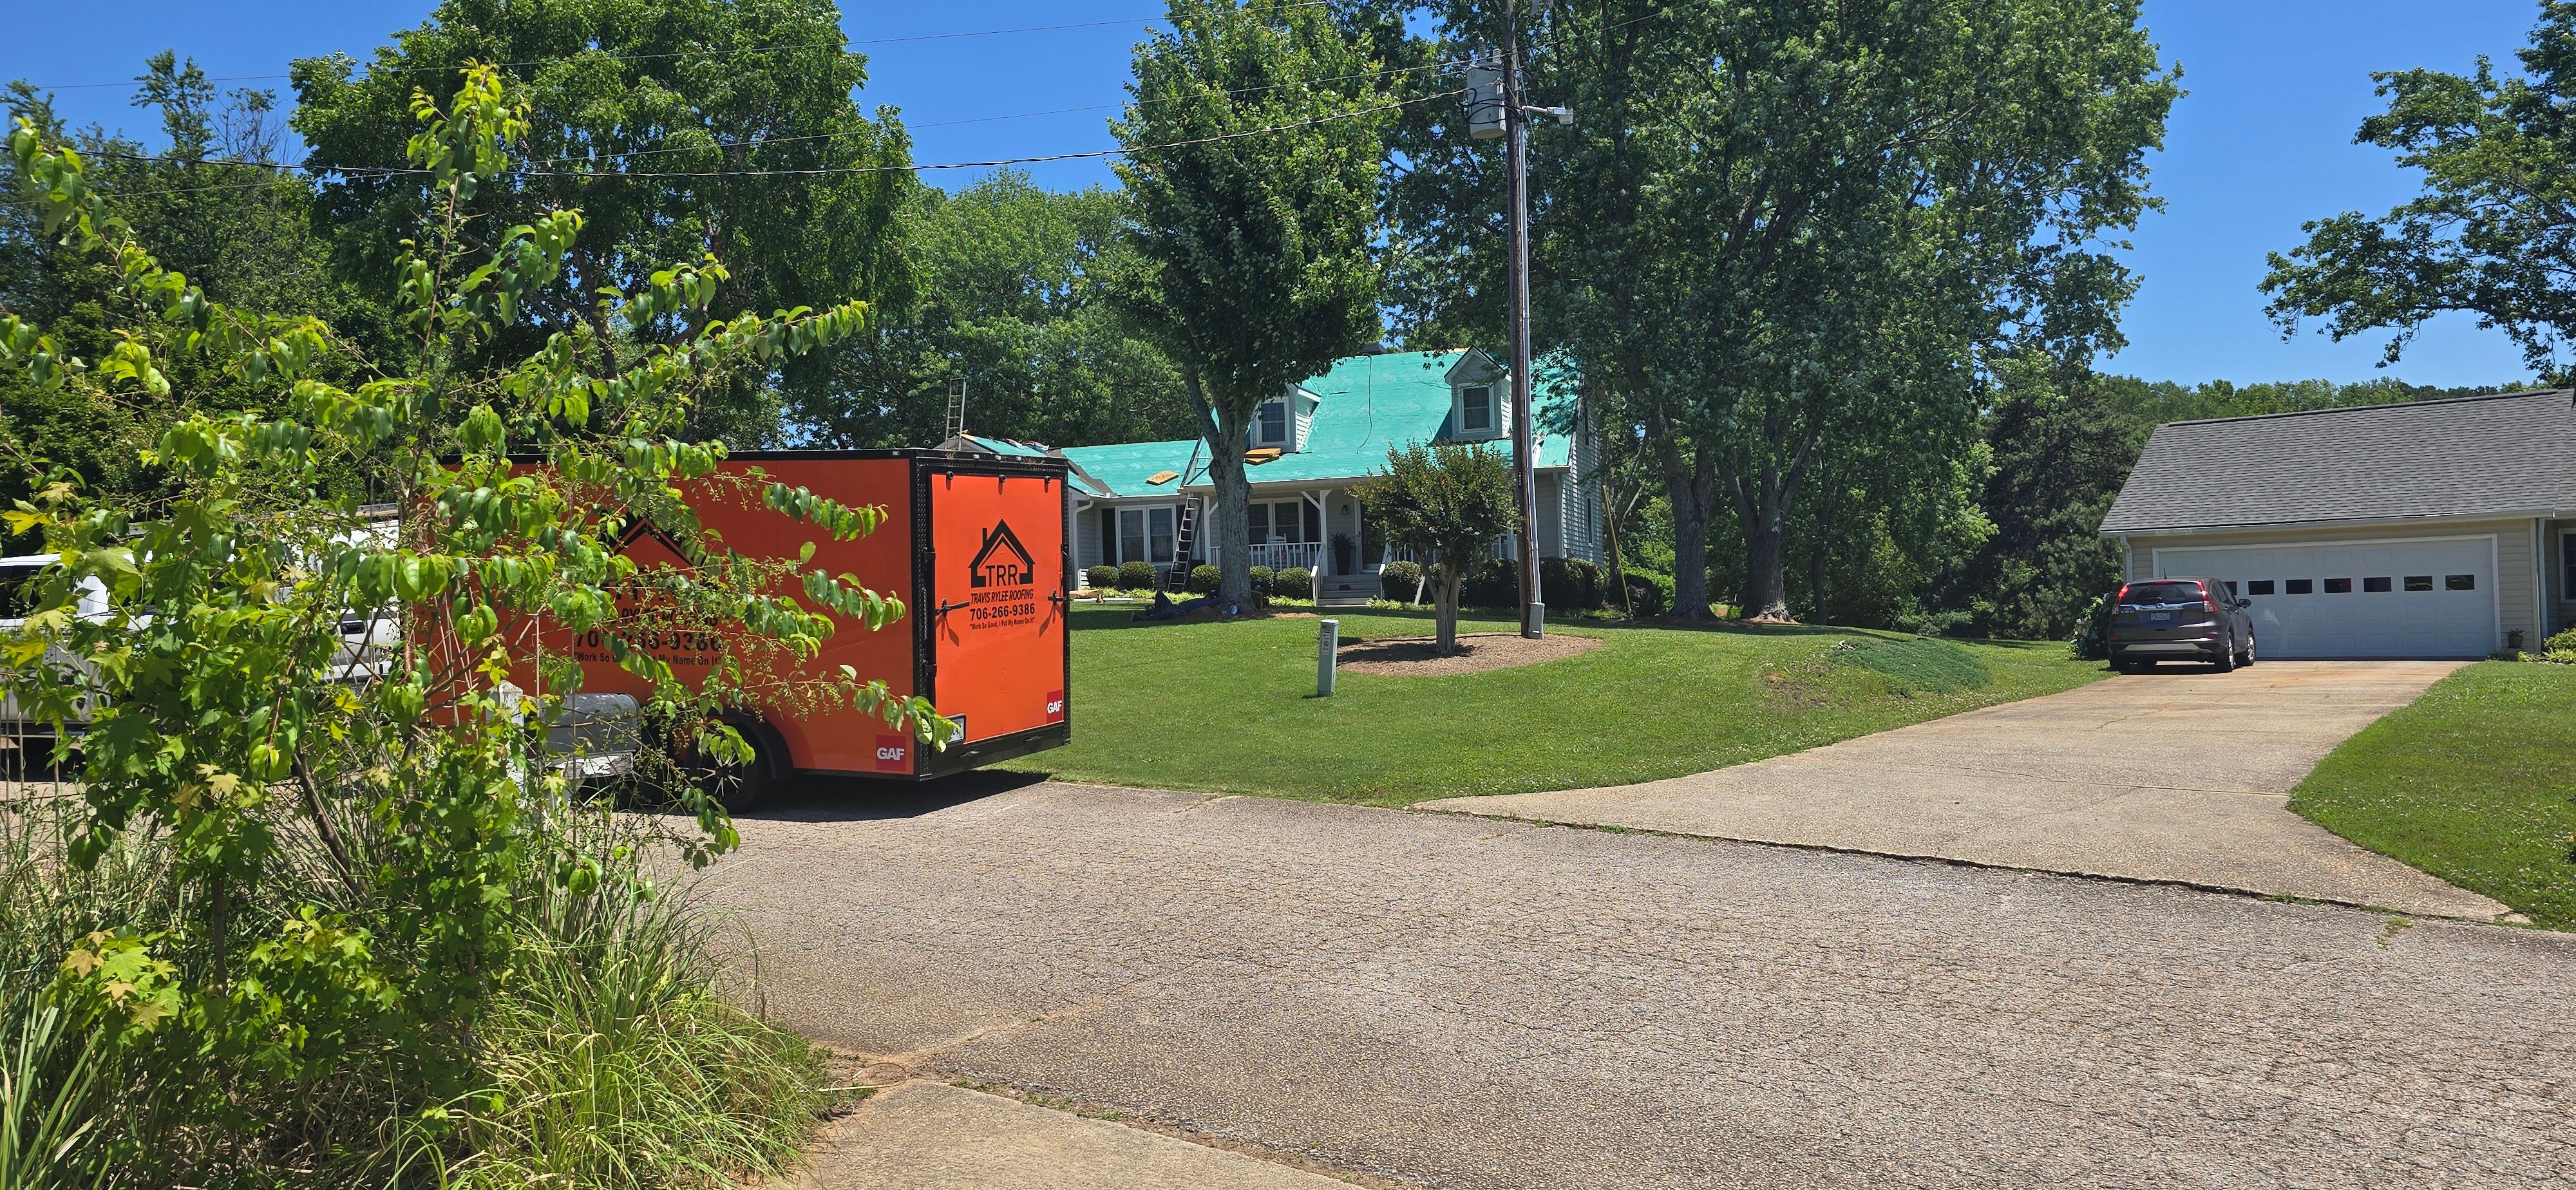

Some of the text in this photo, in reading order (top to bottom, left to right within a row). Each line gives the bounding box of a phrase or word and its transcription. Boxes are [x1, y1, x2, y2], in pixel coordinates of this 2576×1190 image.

[985, 564, 1018, 587] TRR
[971, 588, 1034, 605] TRAVIS RYLEE ROOFING
[970, 603, 1036, 621] 706-266-9386
[600, 652, 610, 663] So
[673, 655, 696, 666] Name
[698, 656, 709, 666] On
[1047, 700, 1063, 714] GAF
[876, 747, 905, 760] GAF
